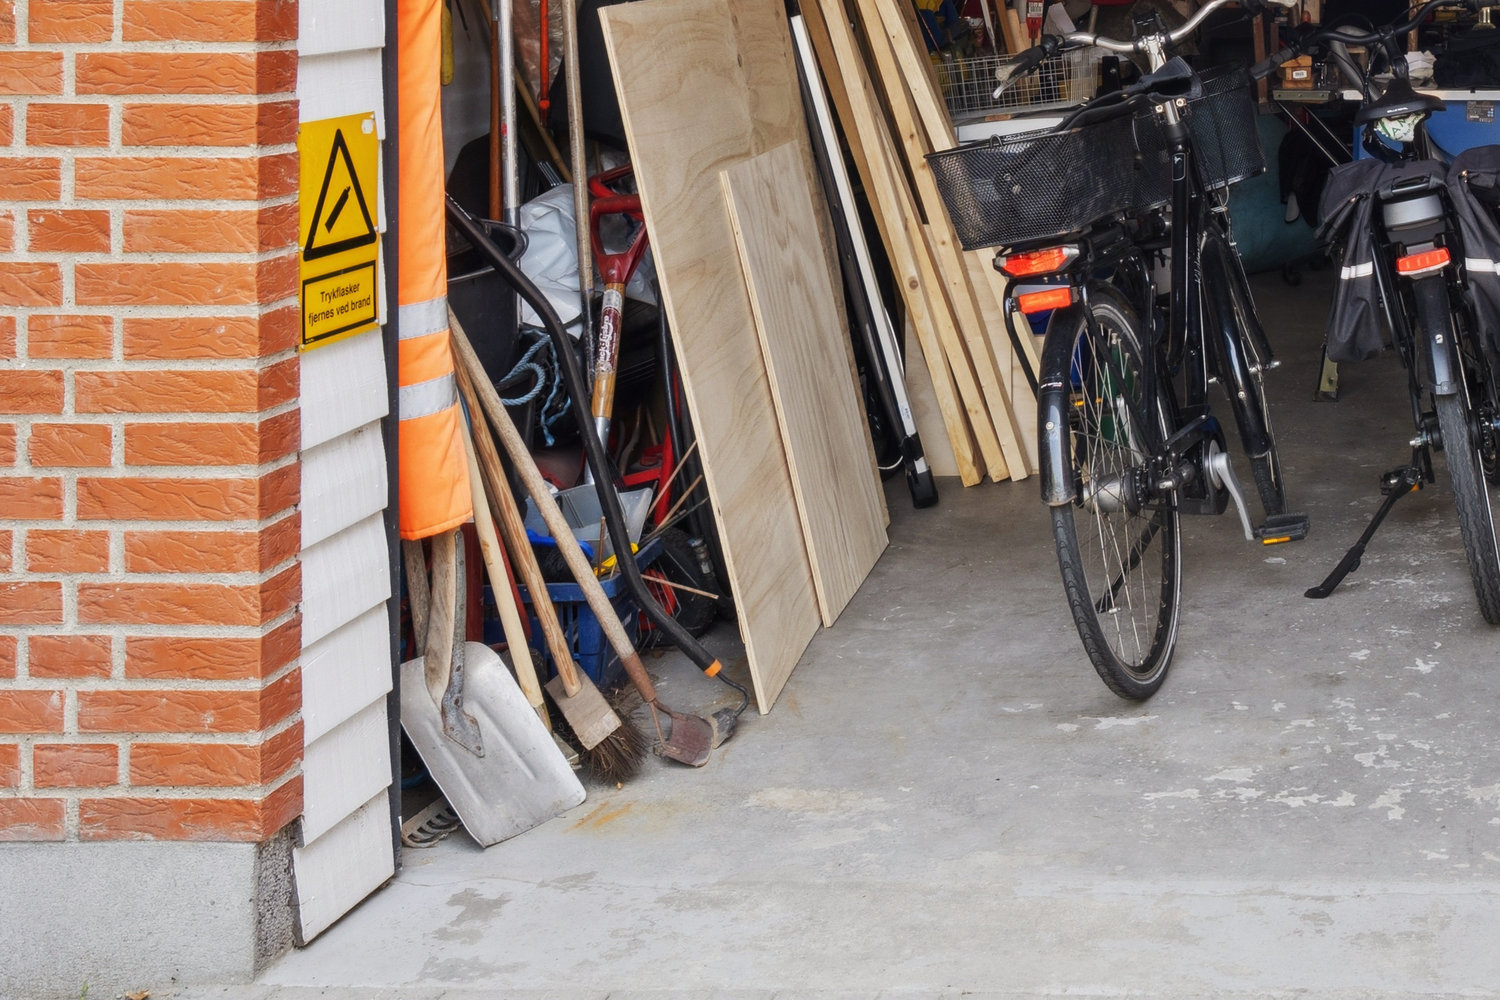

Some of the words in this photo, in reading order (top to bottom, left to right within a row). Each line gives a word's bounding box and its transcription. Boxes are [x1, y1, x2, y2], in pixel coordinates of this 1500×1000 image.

[320, 282, 360, 304] Trykflasker
[308, 308, 335, 327] fjernes
[336, 301, 350, 315] ved
[350, 294, 372, 311] brand
